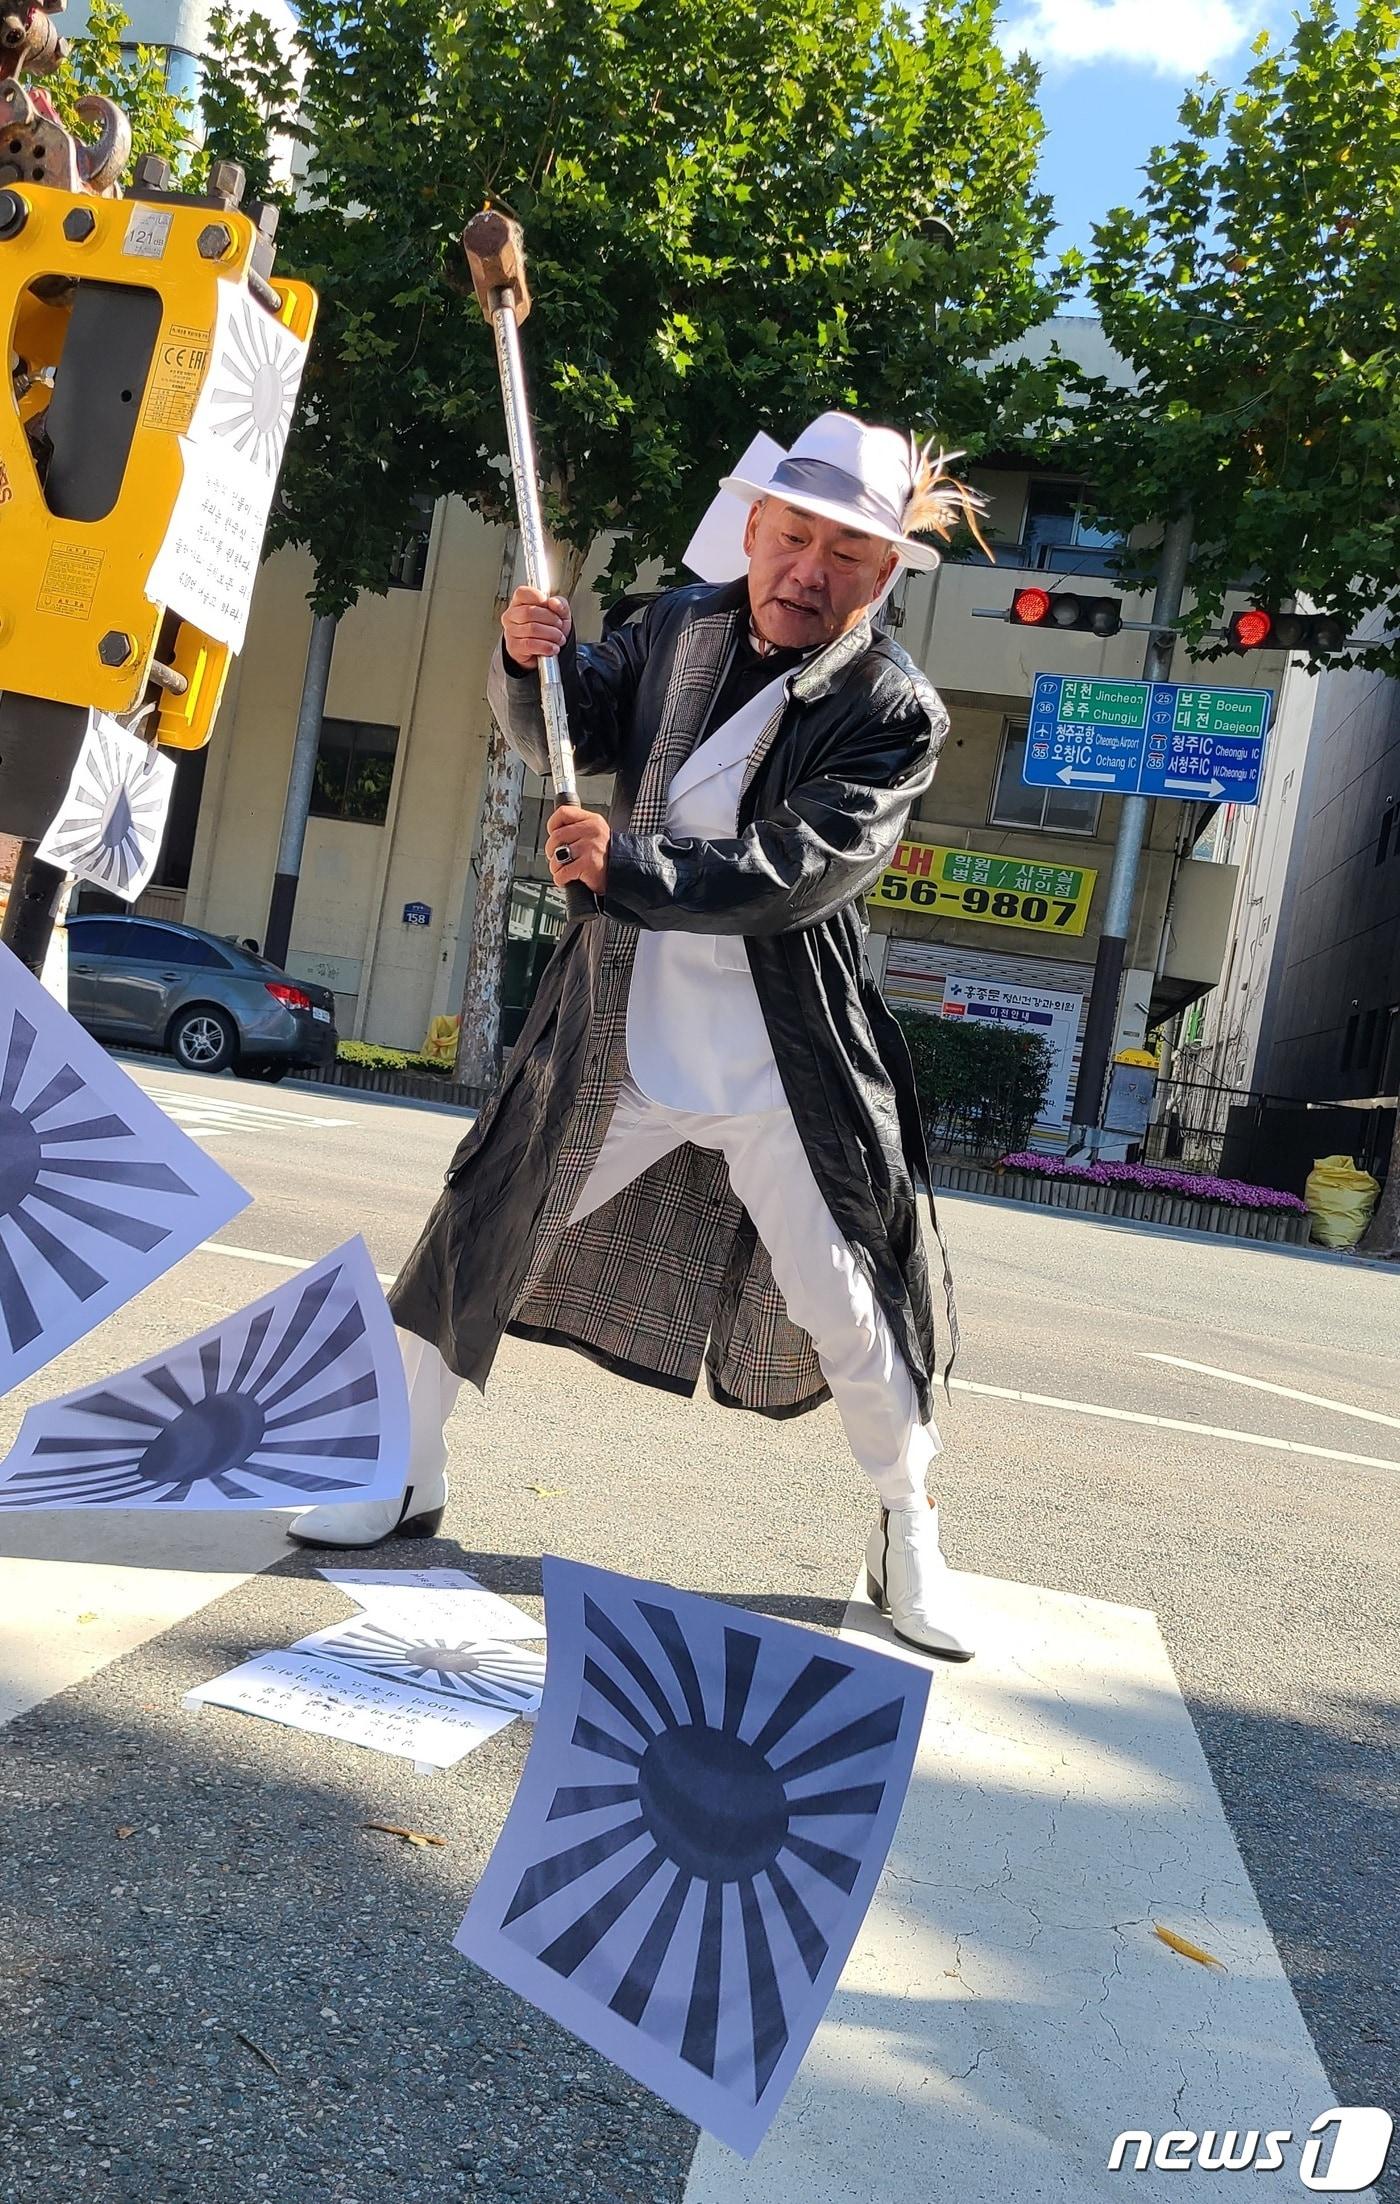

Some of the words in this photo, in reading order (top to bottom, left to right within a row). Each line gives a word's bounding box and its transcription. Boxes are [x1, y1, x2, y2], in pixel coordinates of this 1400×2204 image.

[130, 230, 154, 245] 121
[164, 347, 187, 368] CE
[1043, 684, 1053, 692] 17
[1065, 683, 1092, 700] 진천
[1095, 690, 1144, 705] Jincheon
[1158, 694, 1170, 703] 25
[1039, 703, 1051, 713] 36
[1062, 701, 1089, 718] 충주
[1093, 709, 1138, 725] Chungju
[1179, 692, 1211, 710] 보은
[1216, 700, 1252, 713] Boeun
[1155, 714, 1167, 722] 17
[1176, 711, 1210, 729] 대전
[1214, 719, 1260, 734] Daejeon
[1055, 723, 1095, 745] 청주공항
[1034, 748, 1046, 758] 35
[1051, 744, 1092, 765] 오창IC
[1095, 754, 1126, 771] Ochang
[1127, 756, 1137, 769] IC
[1171, 735, 1214, 756] 청주IC
[1215, 745, 1248, 761] Cheongju
[1251, 748, 1260, 760] IC
[1149, 758, 1161, 768] 35
[1167, 755, 1211, 776] 서청주IC
[1249, 768, 1257, 780] IC
[954, 854, 992, 872] 학원
[1016, 864, 1076, 885] 사무실
[952, 867, 989, 885] 병원
[1013, 878, 1072, 897] 체인점
[870, 874, 1077, 927] 56-9807
[964, 985, 1000, 1002] 홍종문
[1002, 993, 1075, 1012] 정신건강과의원
[990, 1007, 1030, 1021] 이전안내
